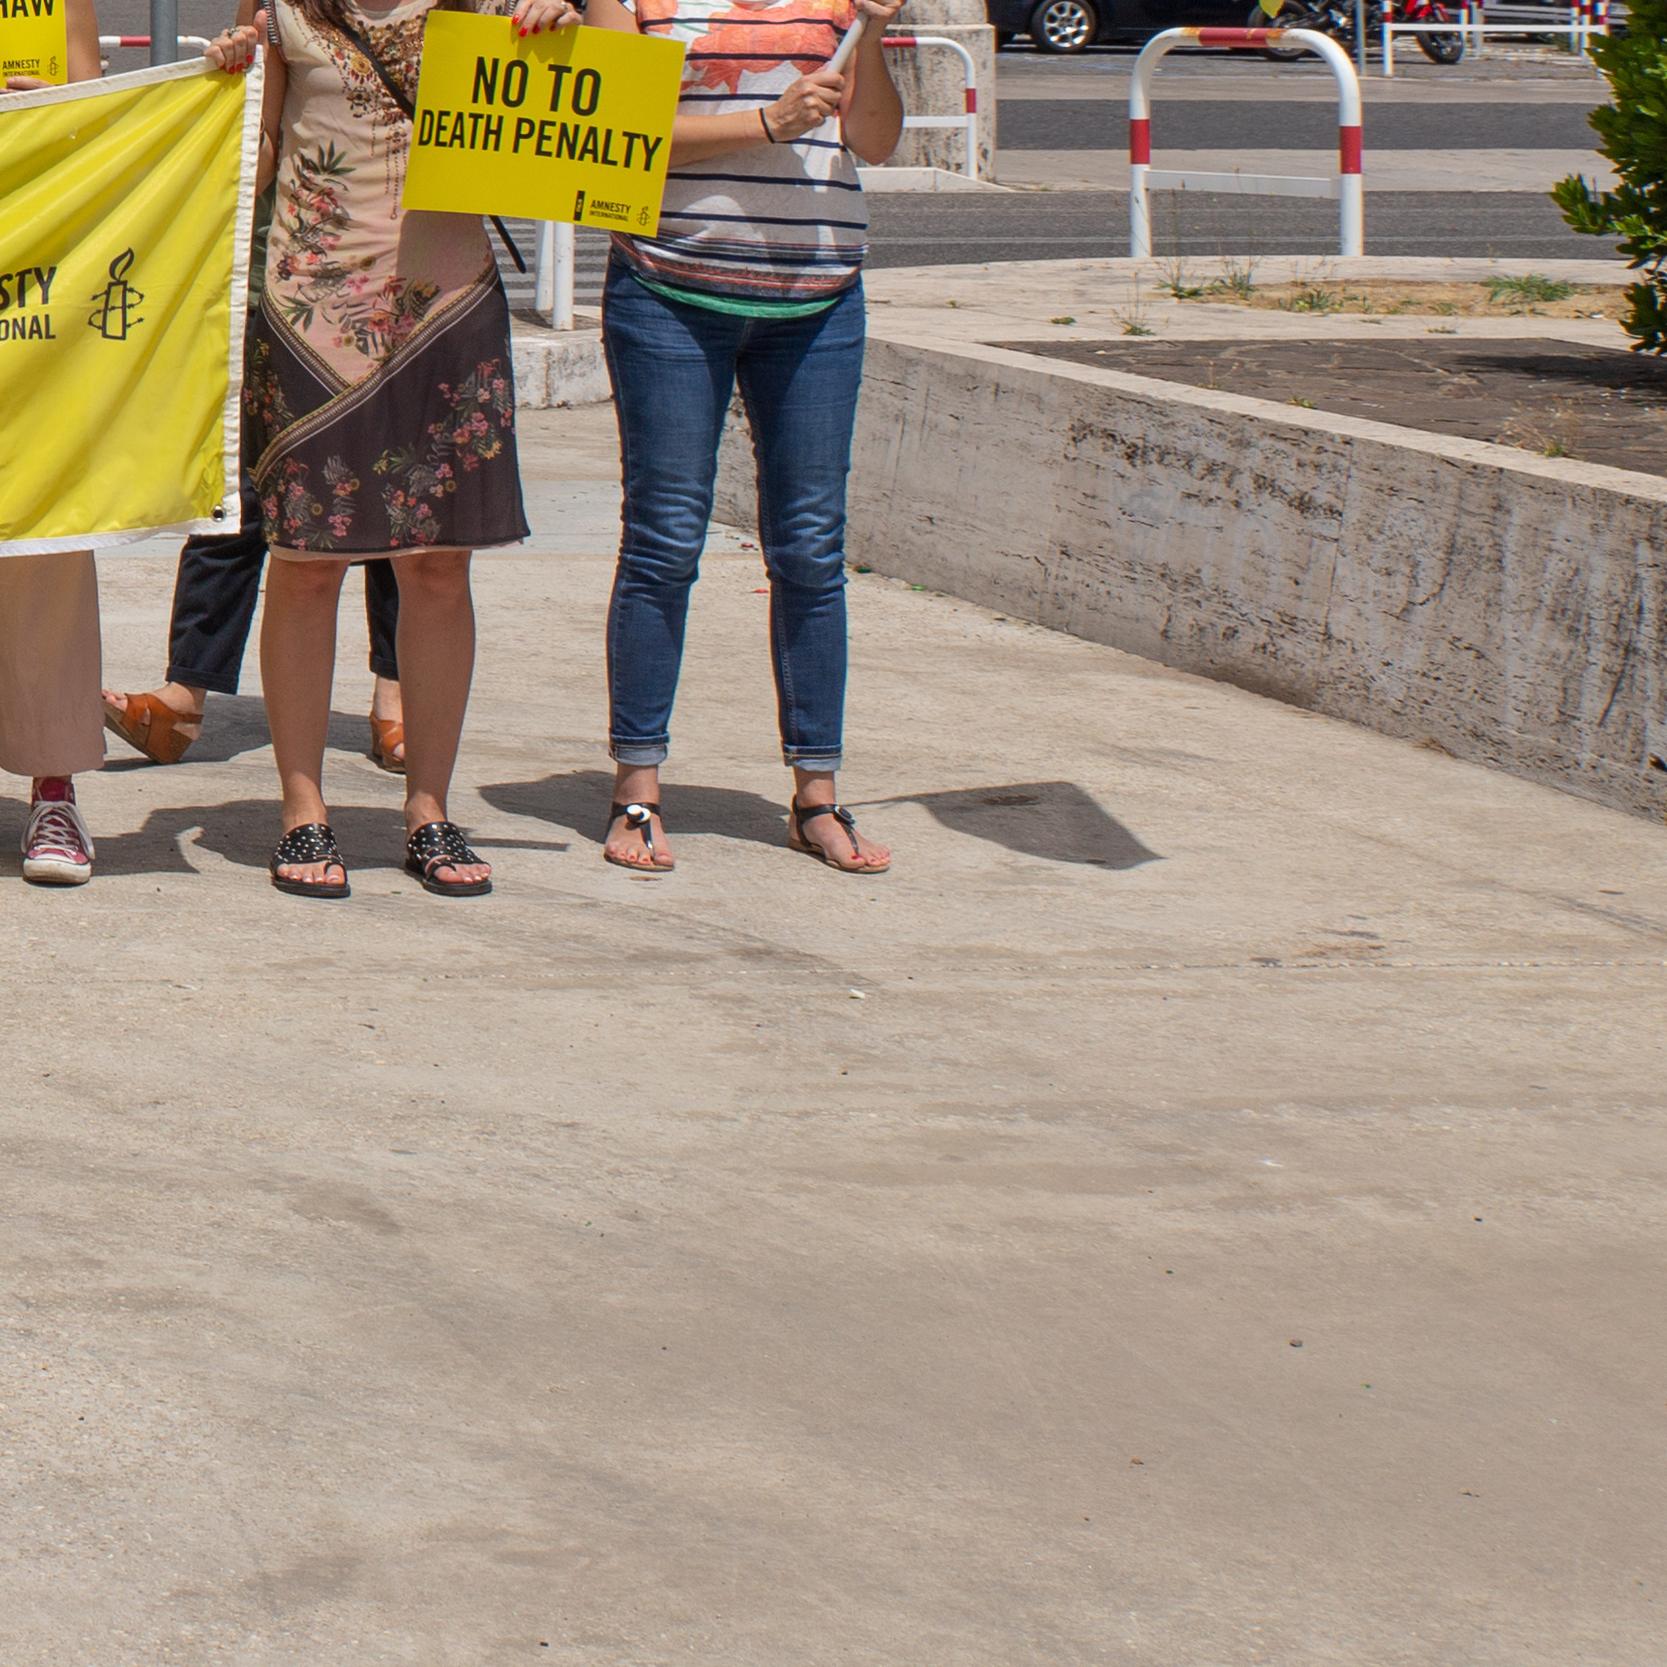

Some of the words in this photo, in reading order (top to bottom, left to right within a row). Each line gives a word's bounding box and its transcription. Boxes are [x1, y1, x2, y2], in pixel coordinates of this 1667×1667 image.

[2, 59, 40, 69] AMNESTY
[471, 56, 529, 108] NO
[547, 63, 602, 116] TO
[418, 109, 504, 152] DEATH
[512, 117, 663, 172] PENALTY
[590, 199, 631, 214] AMNESTY
[589, 210, 629, 222] INTERNATIONAL
